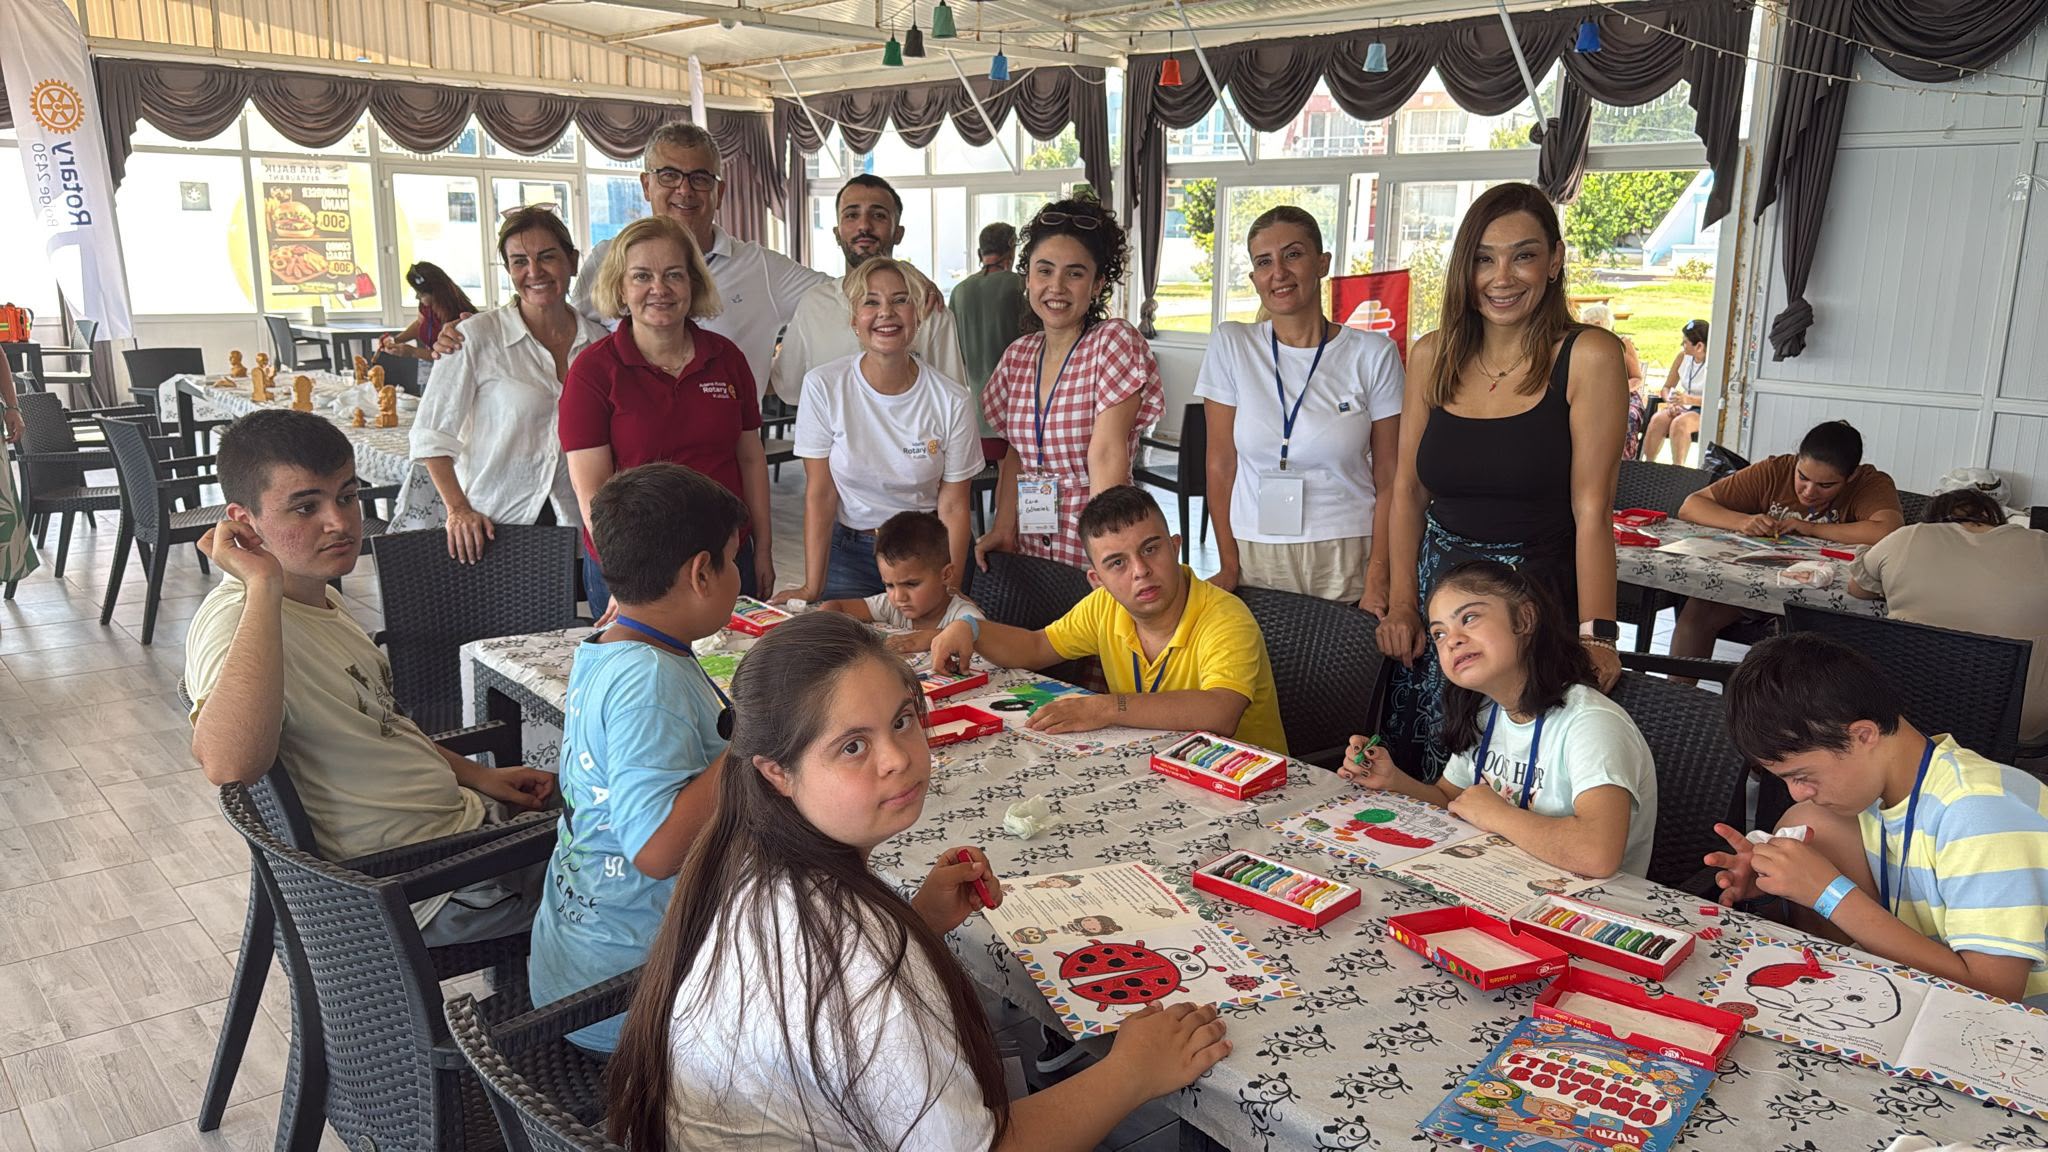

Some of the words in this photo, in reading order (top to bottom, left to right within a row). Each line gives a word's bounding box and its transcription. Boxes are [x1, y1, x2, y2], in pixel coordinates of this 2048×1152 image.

[702, 386, 728, 394] Rotary
[902, 447, 927, 455] Rotary
[1489, 975, 1509, 984] pastels
[1508, 1066, 1658, 1125] BOYAMA
